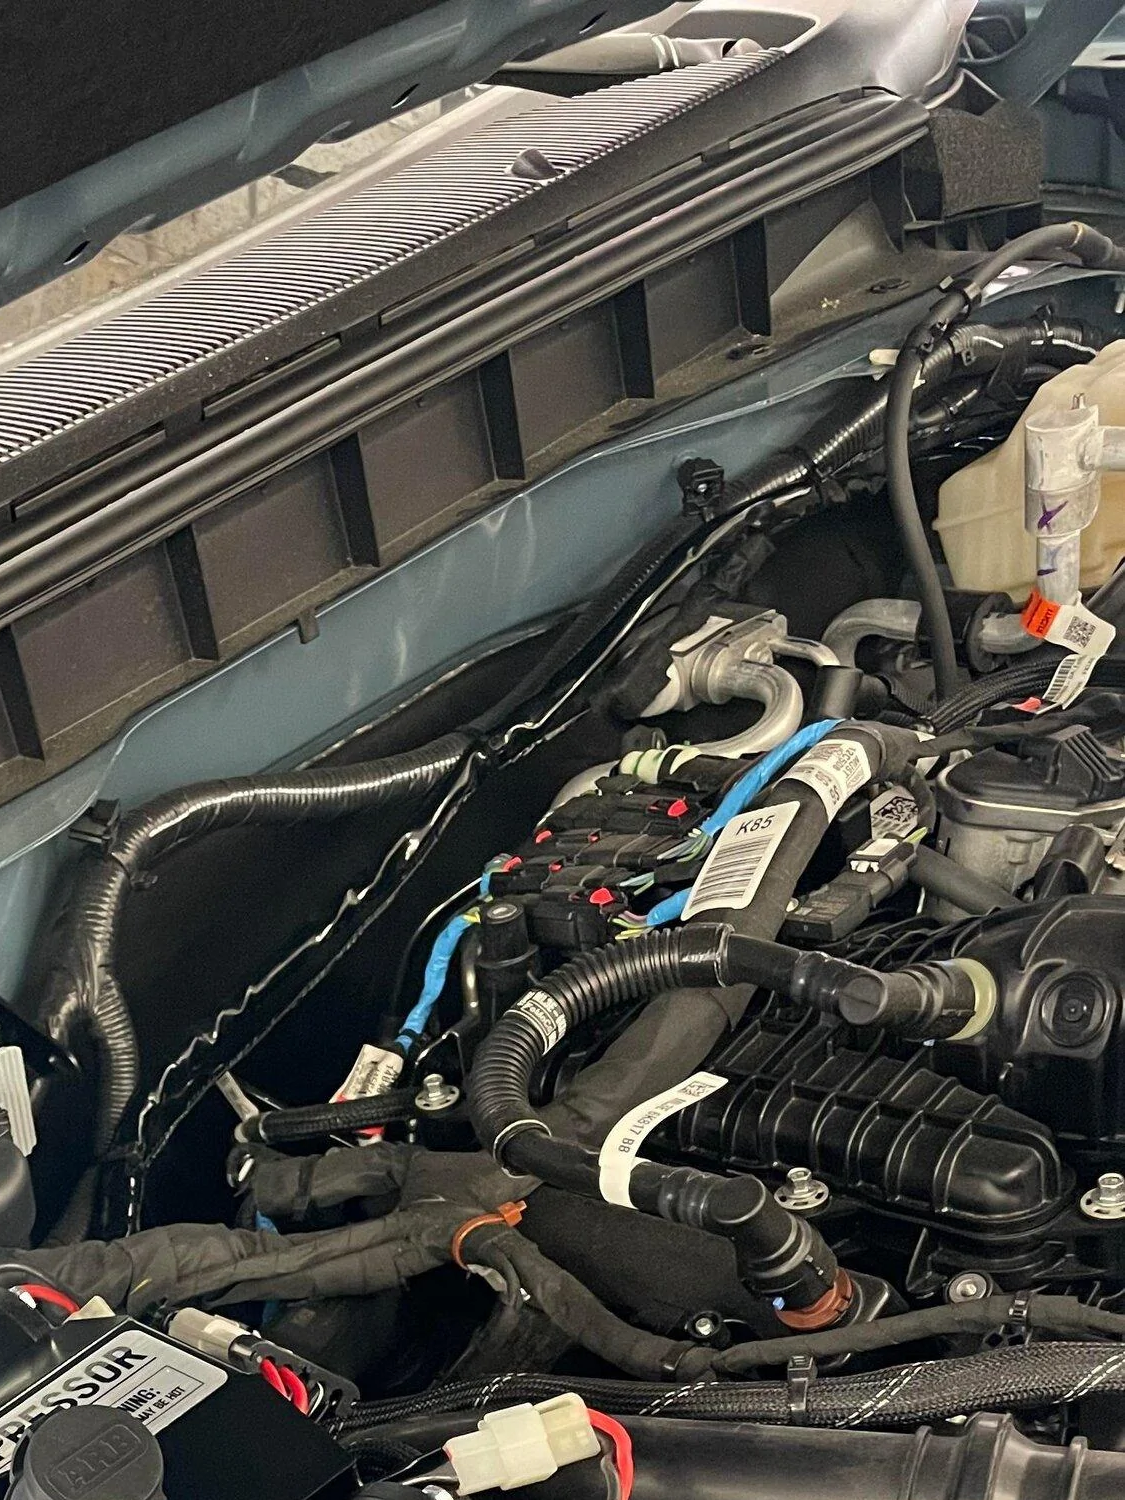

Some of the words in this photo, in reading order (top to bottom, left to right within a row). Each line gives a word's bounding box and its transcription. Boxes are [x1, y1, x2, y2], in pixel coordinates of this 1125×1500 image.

[736, 815, 774, 836] K85
[119, 1387, 161, 1414] NING:
[153, 1398, 169, 1409] BE
[165, 1386, 186, 1401] HOT
[58, 1433, 134, 1490] ARB
